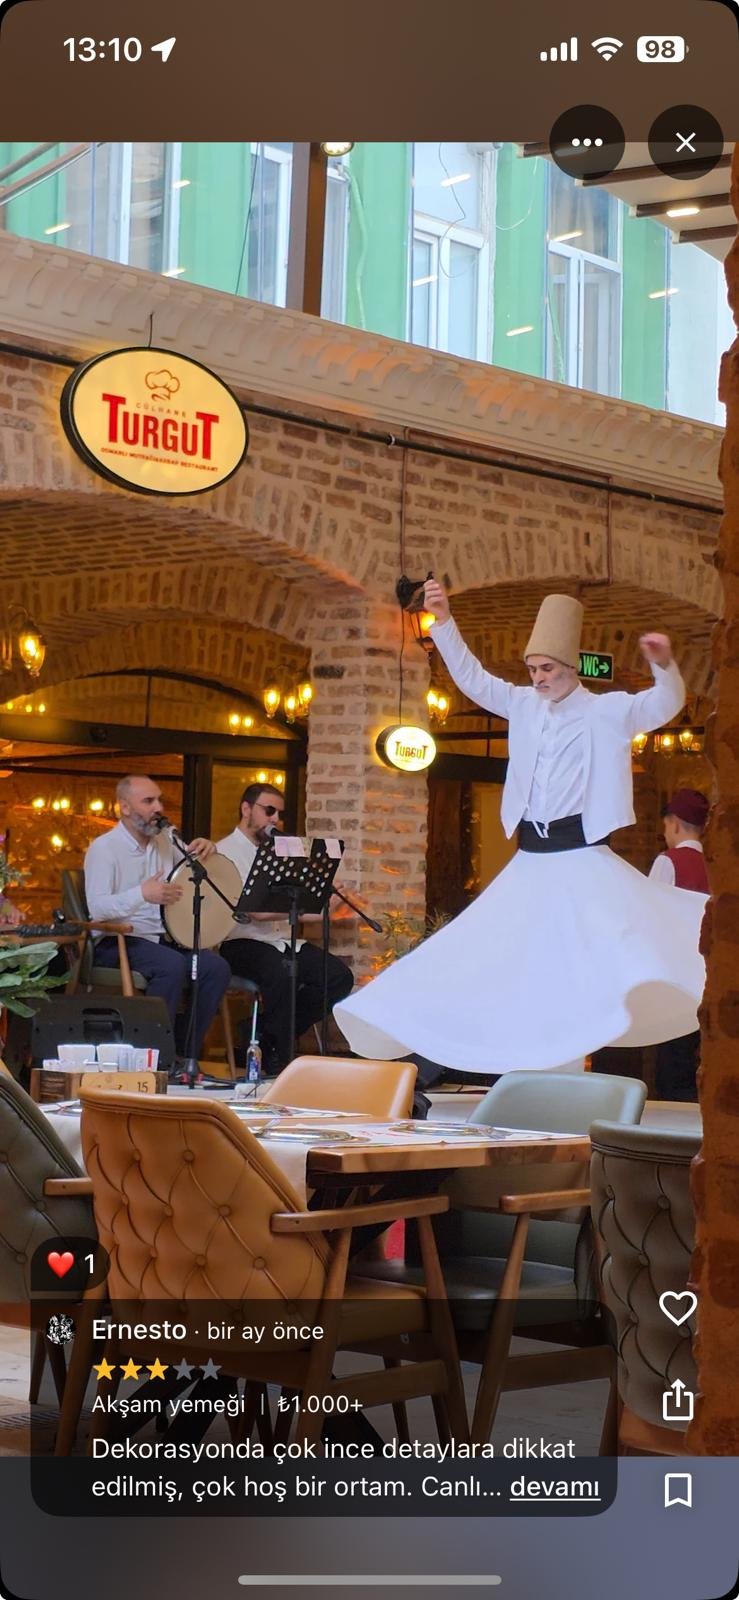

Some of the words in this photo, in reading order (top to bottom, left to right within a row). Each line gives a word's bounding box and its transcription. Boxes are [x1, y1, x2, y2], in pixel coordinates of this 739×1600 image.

[102, 393, 220, 460] TURGUT
[583, 655, 599, 677] WC
[395, 741, 428, 759] TURGUT
